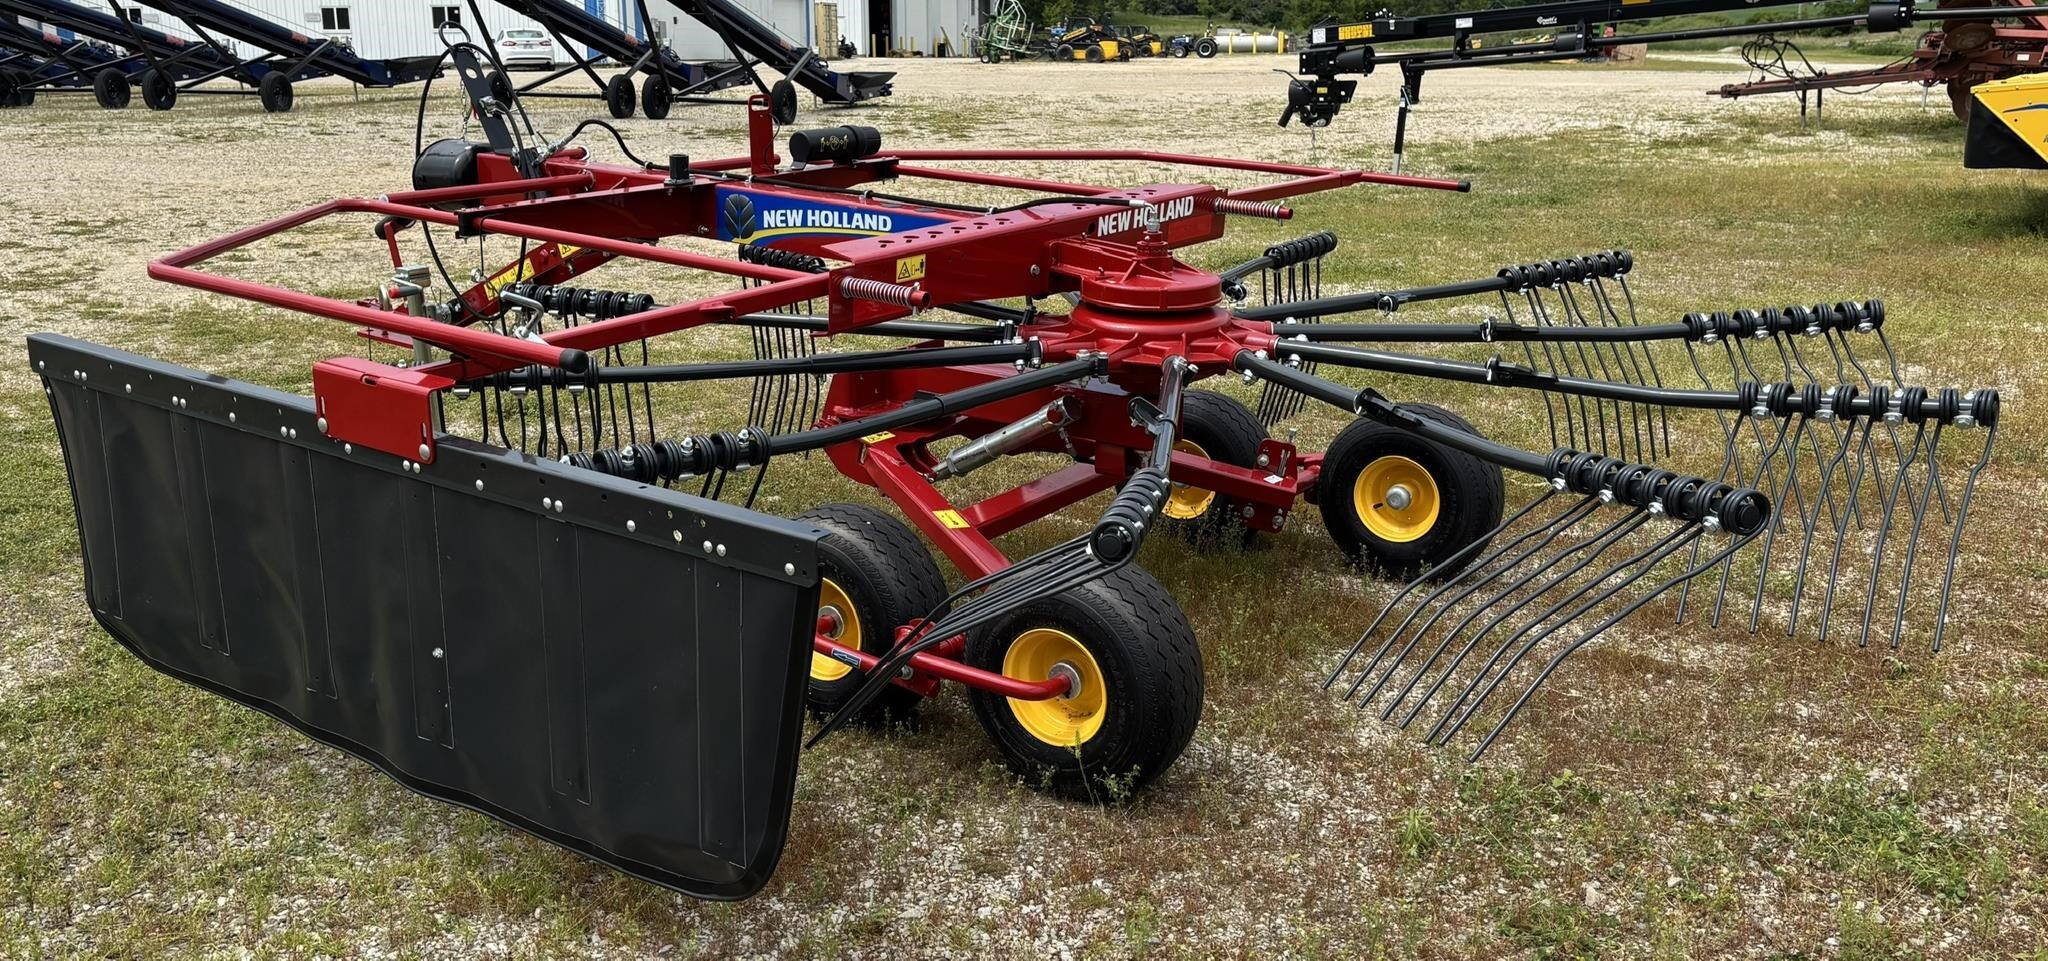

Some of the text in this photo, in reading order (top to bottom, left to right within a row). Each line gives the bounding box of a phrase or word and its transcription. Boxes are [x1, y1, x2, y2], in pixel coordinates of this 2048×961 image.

[763, 209, 892, 232] NEW HOLLAND
[1097, 209, 1132, 237] NEW
